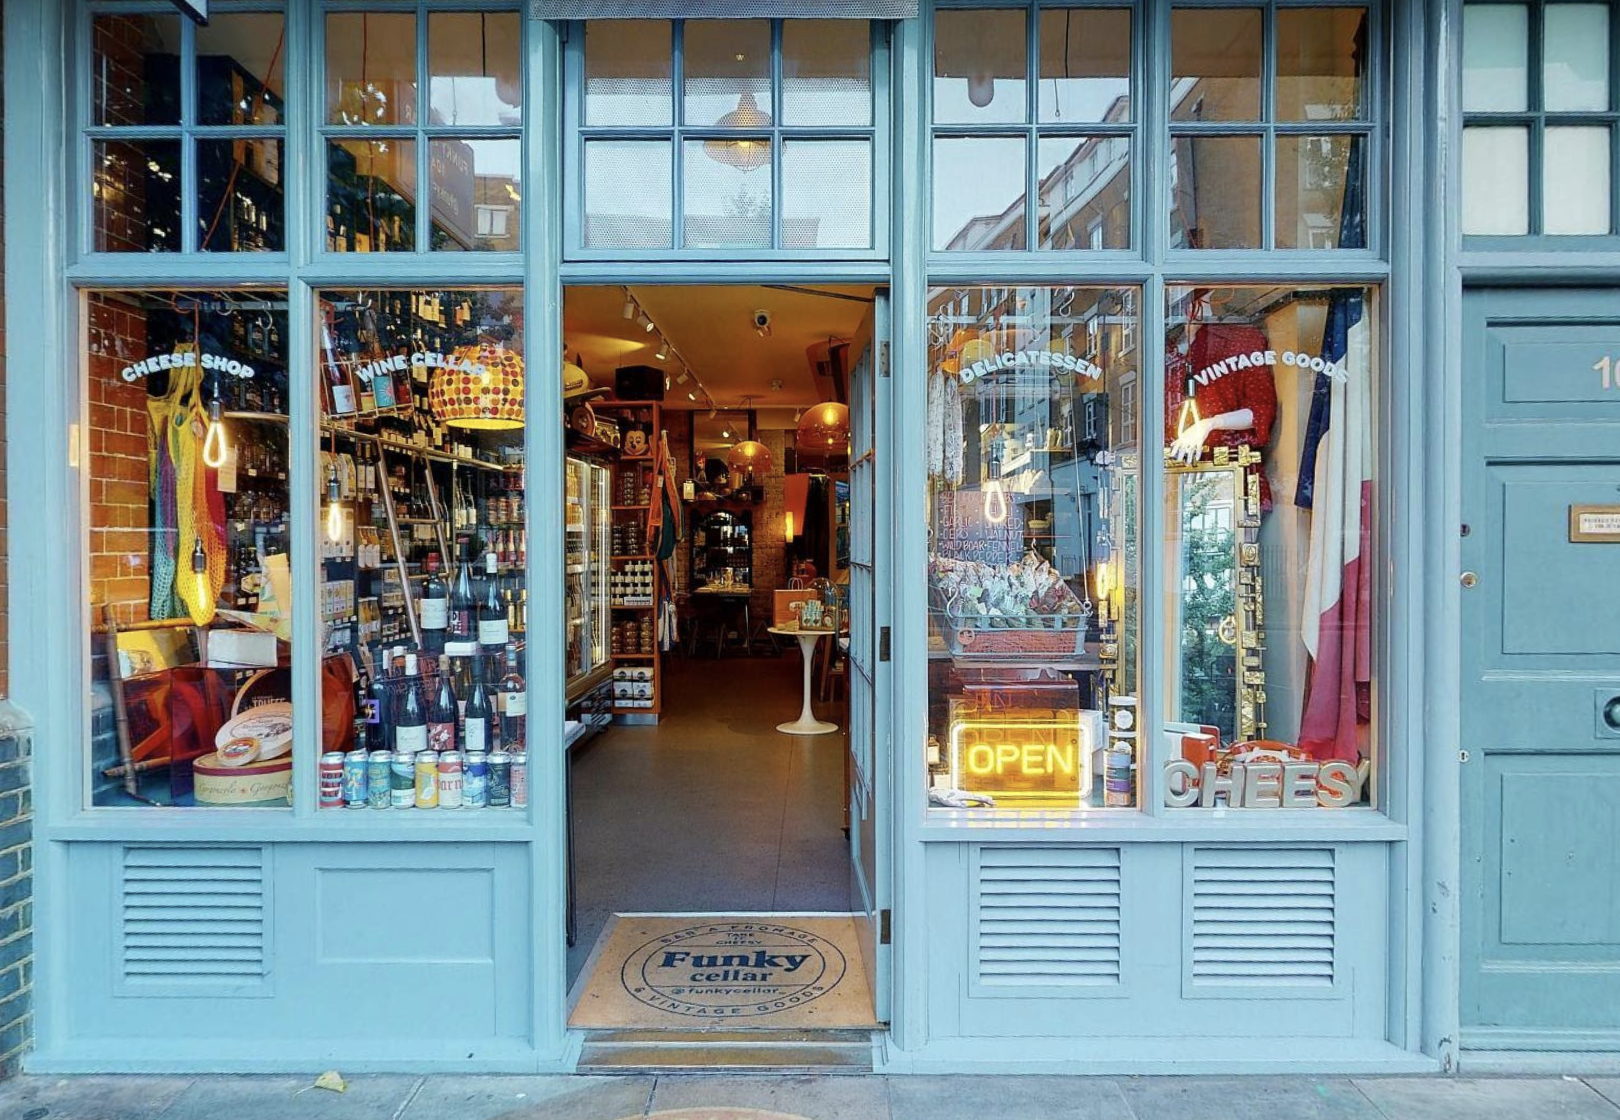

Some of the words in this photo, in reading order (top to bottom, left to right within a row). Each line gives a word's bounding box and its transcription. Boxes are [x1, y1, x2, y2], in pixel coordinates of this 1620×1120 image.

[122, 352, 196, 382] CHEESE
[200, 353, 255, 379] SHOP
[355, 354, 408, 383] WINE
[411, 351, 486, 375] CELLAR
[959, 350, 1102, 384] DELICATESSEN
[1193, 350, 1277, 387] VINTAGE
[1281, 351, 1349, 383] GOODS
[963, 541, 985, 551] BOAR
[986, 541, 1022, 551] FENNEL
[985, 530, 1023, 540] WALNUT
[968, 744, 1073, 775] OPEN
[731, 924, 818, 944] FROMAGE
[657, 950, 812, 972] Funky
[690, 969, 773, 982] cellar
[649, 995, 742, 1014] VINTAGE
[757, 986, 824, 1011] GOODS
